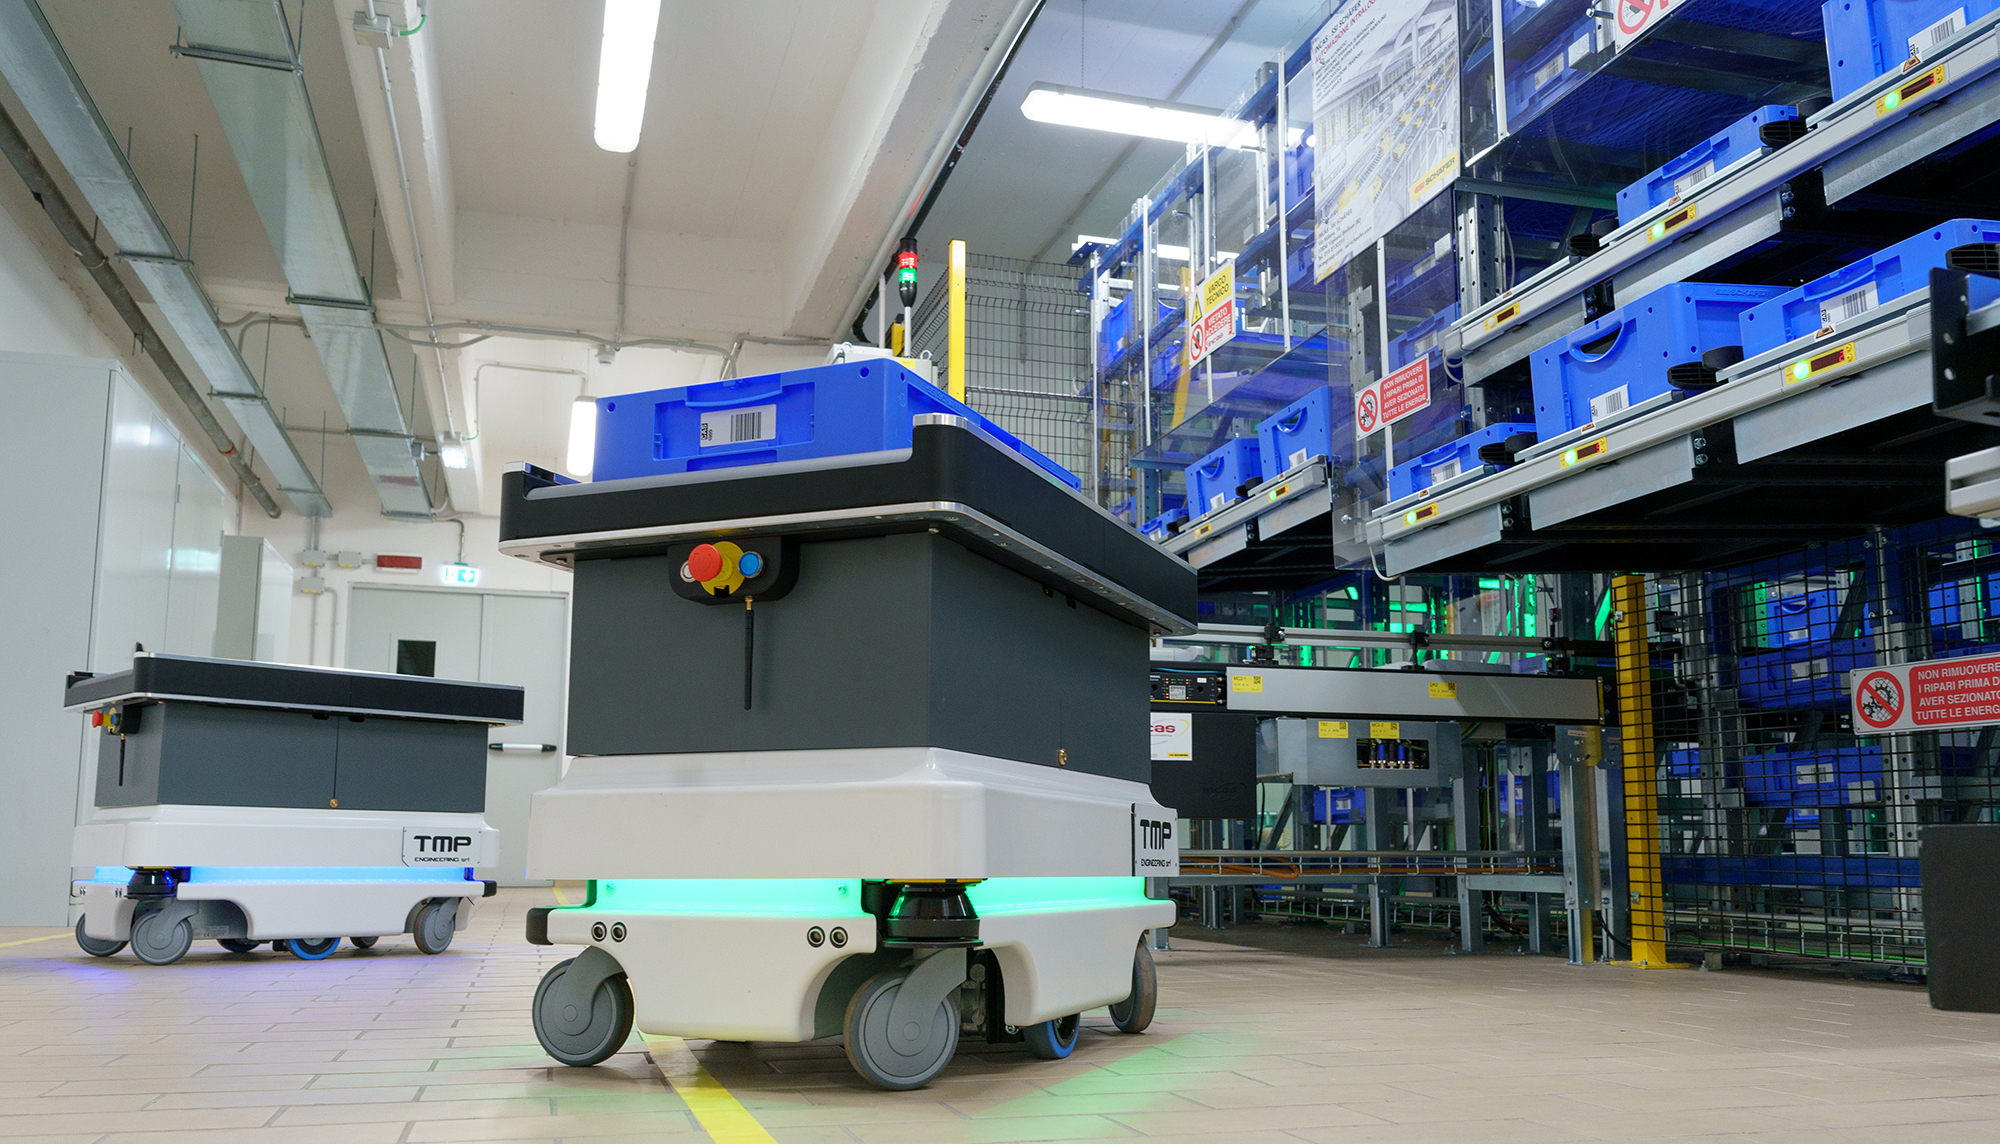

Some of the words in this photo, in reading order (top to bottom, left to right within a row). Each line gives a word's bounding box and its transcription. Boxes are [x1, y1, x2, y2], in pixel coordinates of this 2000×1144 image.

[1314, 35, 1328, 53] INCAS
[1208, 275, 1226, 294] VARCO
[1206, 283, 1229, 306] TECNICO
[1207, 306, 1228, 326] VIETATO
[1383, 380, 1394, 390] NON
[1394, 364, 1423, 383] RIMUOVERE
[1386, 386, 1402, 398] RIPARI
[1402, 377, 1418, 390] PRIMA
[1418, 374, 1424, 382] DI
[1383, 408, 1397, 419] TUTTE
[1398, 403, 1405, 412] LE
[1405, 392, 1427, 409] ENERGIE
[1384, 399, 1397, 409] AVER
[1397, 384, 1425, 403] SEZIONATO
[1917, 669, 1939, 680] NON
[1941, 662, 2000, 678] RIMUOVERE
[1924, 681, 1956, 693] RIPARI
[1958, 677, 1990, 690] PRIMA
[1992, 676, 2000, 686] D
[1919, 695, 1945, 707] AVER
[1916, 708, 1947, 720] TUTTE
[1949, 707, 1962, 718] LE
[1964, 704, 2000, 716] ENERG
[413, 835, 472, 852] TMP
[1140, 819, 1172, 850] TMP
[1141, 858, 1165, 867] ENGINEERING
